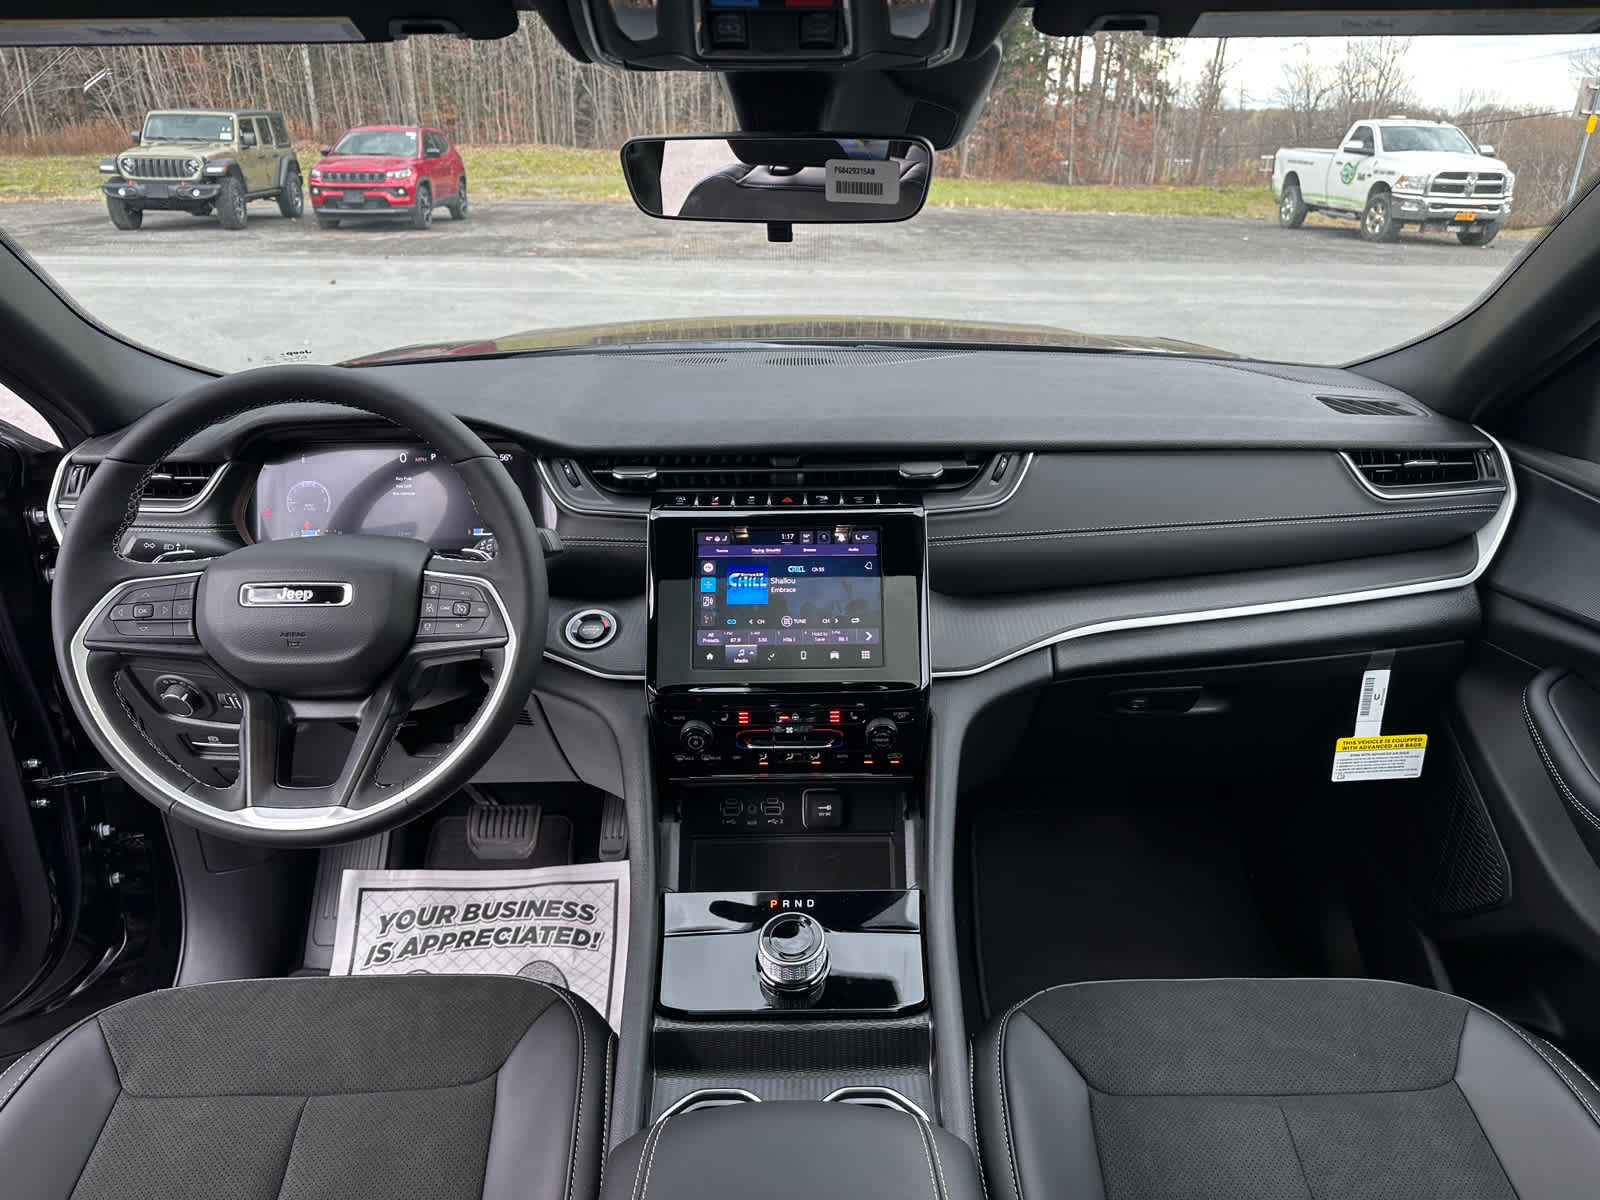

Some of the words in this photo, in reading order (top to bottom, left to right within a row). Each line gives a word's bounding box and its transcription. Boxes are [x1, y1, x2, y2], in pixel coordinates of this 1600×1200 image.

[399, 452, 407, 463] 0
[728, 573, 768, 587] CHILL
[276, 587, 314, 602] Jeep
[770, 899, 779, 909] P
[782, 899, 790, 908] R
[794, 899, 803, 908] N
[806, 899, 815, 908] D
[377, 904, 457, 937] YOUR
[461, 899, 599, 923] BUSINESS
[364, 941, 396, 966] IS
[396, 925, 604, 961] APPRECIATED!
